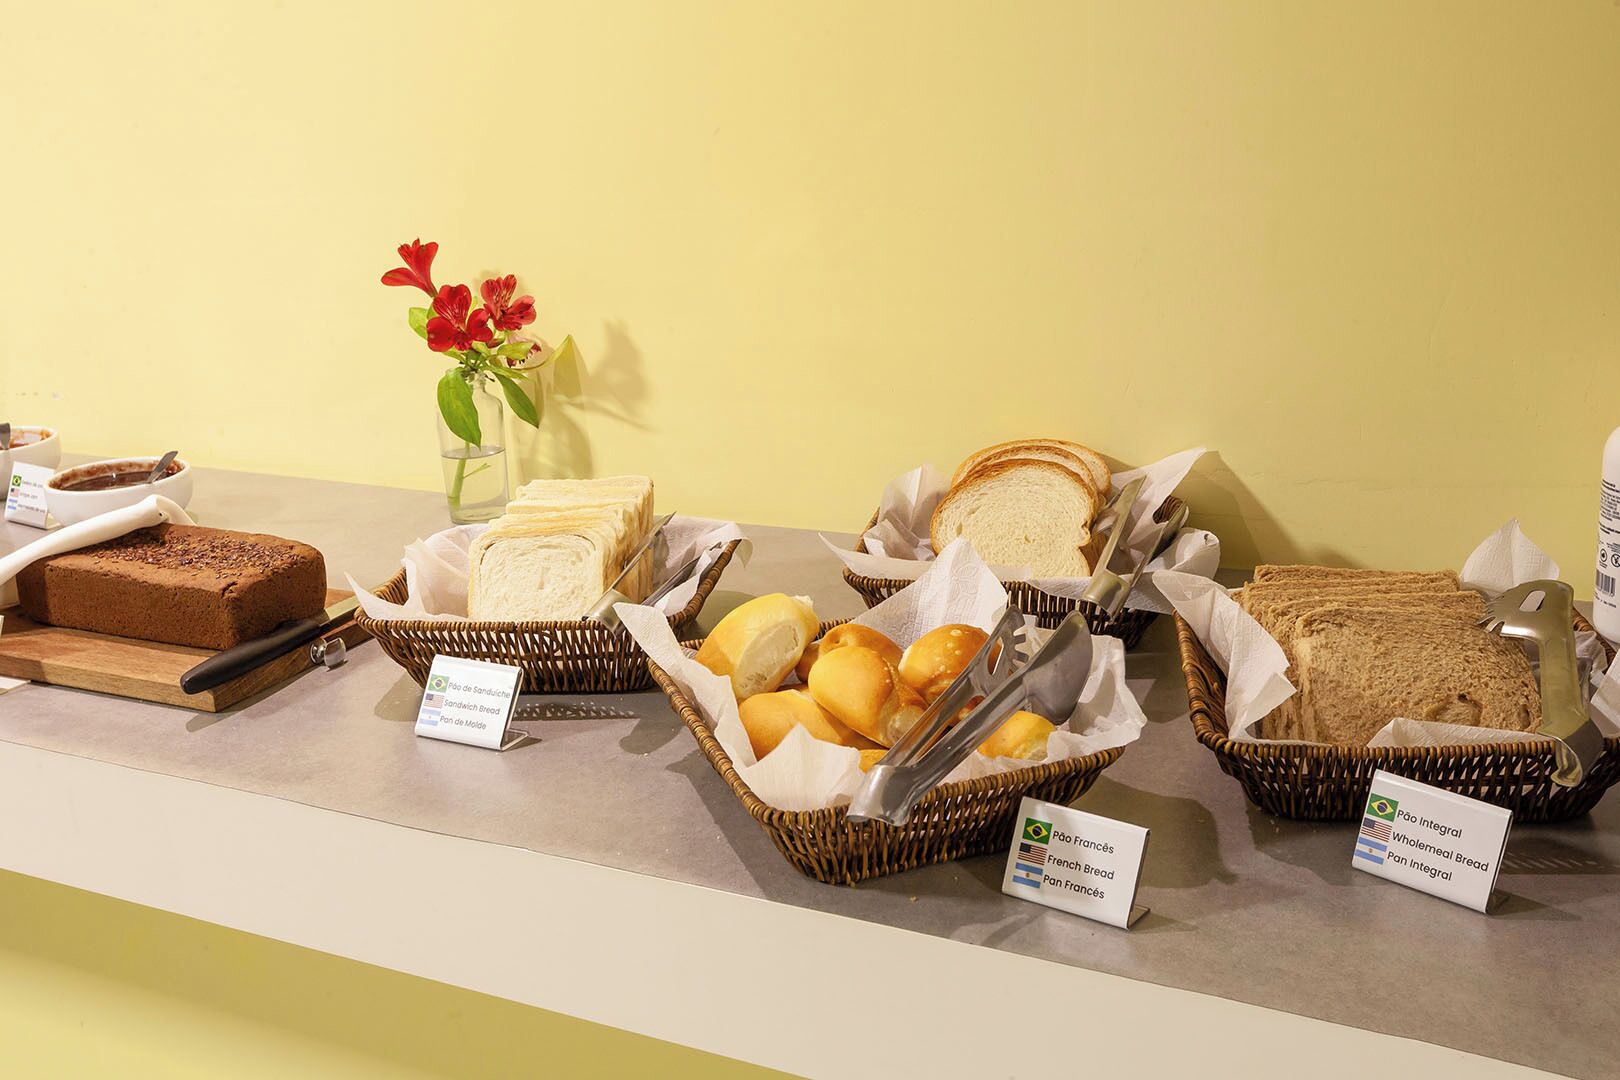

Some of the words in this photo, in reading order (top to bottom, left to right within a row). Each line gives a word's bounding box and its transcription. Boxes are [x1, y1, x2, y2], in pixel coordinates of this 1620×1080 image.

[448, 682, 462, 691] Pão
[462, 684, 472, 693] de
[444, 699, 478, 711] Sandwich
[479, 705, 501, 715] Bread
[440, 715, 454, 724] Pan
[454, 718, 464, 726] de
[464, 720, 487, 730] Molde
[1397, 809, 1417, 824] Pão
[1419, 817, 1463, 839] Integral
[1052, 830, 1072, 843] Pão
[1073, 836, 1114, 854] Francês
[1392, 831, 1454, 860] Wholemeal
[1455, 852, 1490, 872] Bread
[1047, 854, 1081, 872] French
[1083, 864, 1115, 880] Bread
[1387, 850, 1408, 866] Pan
[1409, 858, 1453, 881] Integral
[1043, 874, 1063, 887] Pan
[1064, 880, 1105, 899] Francés
